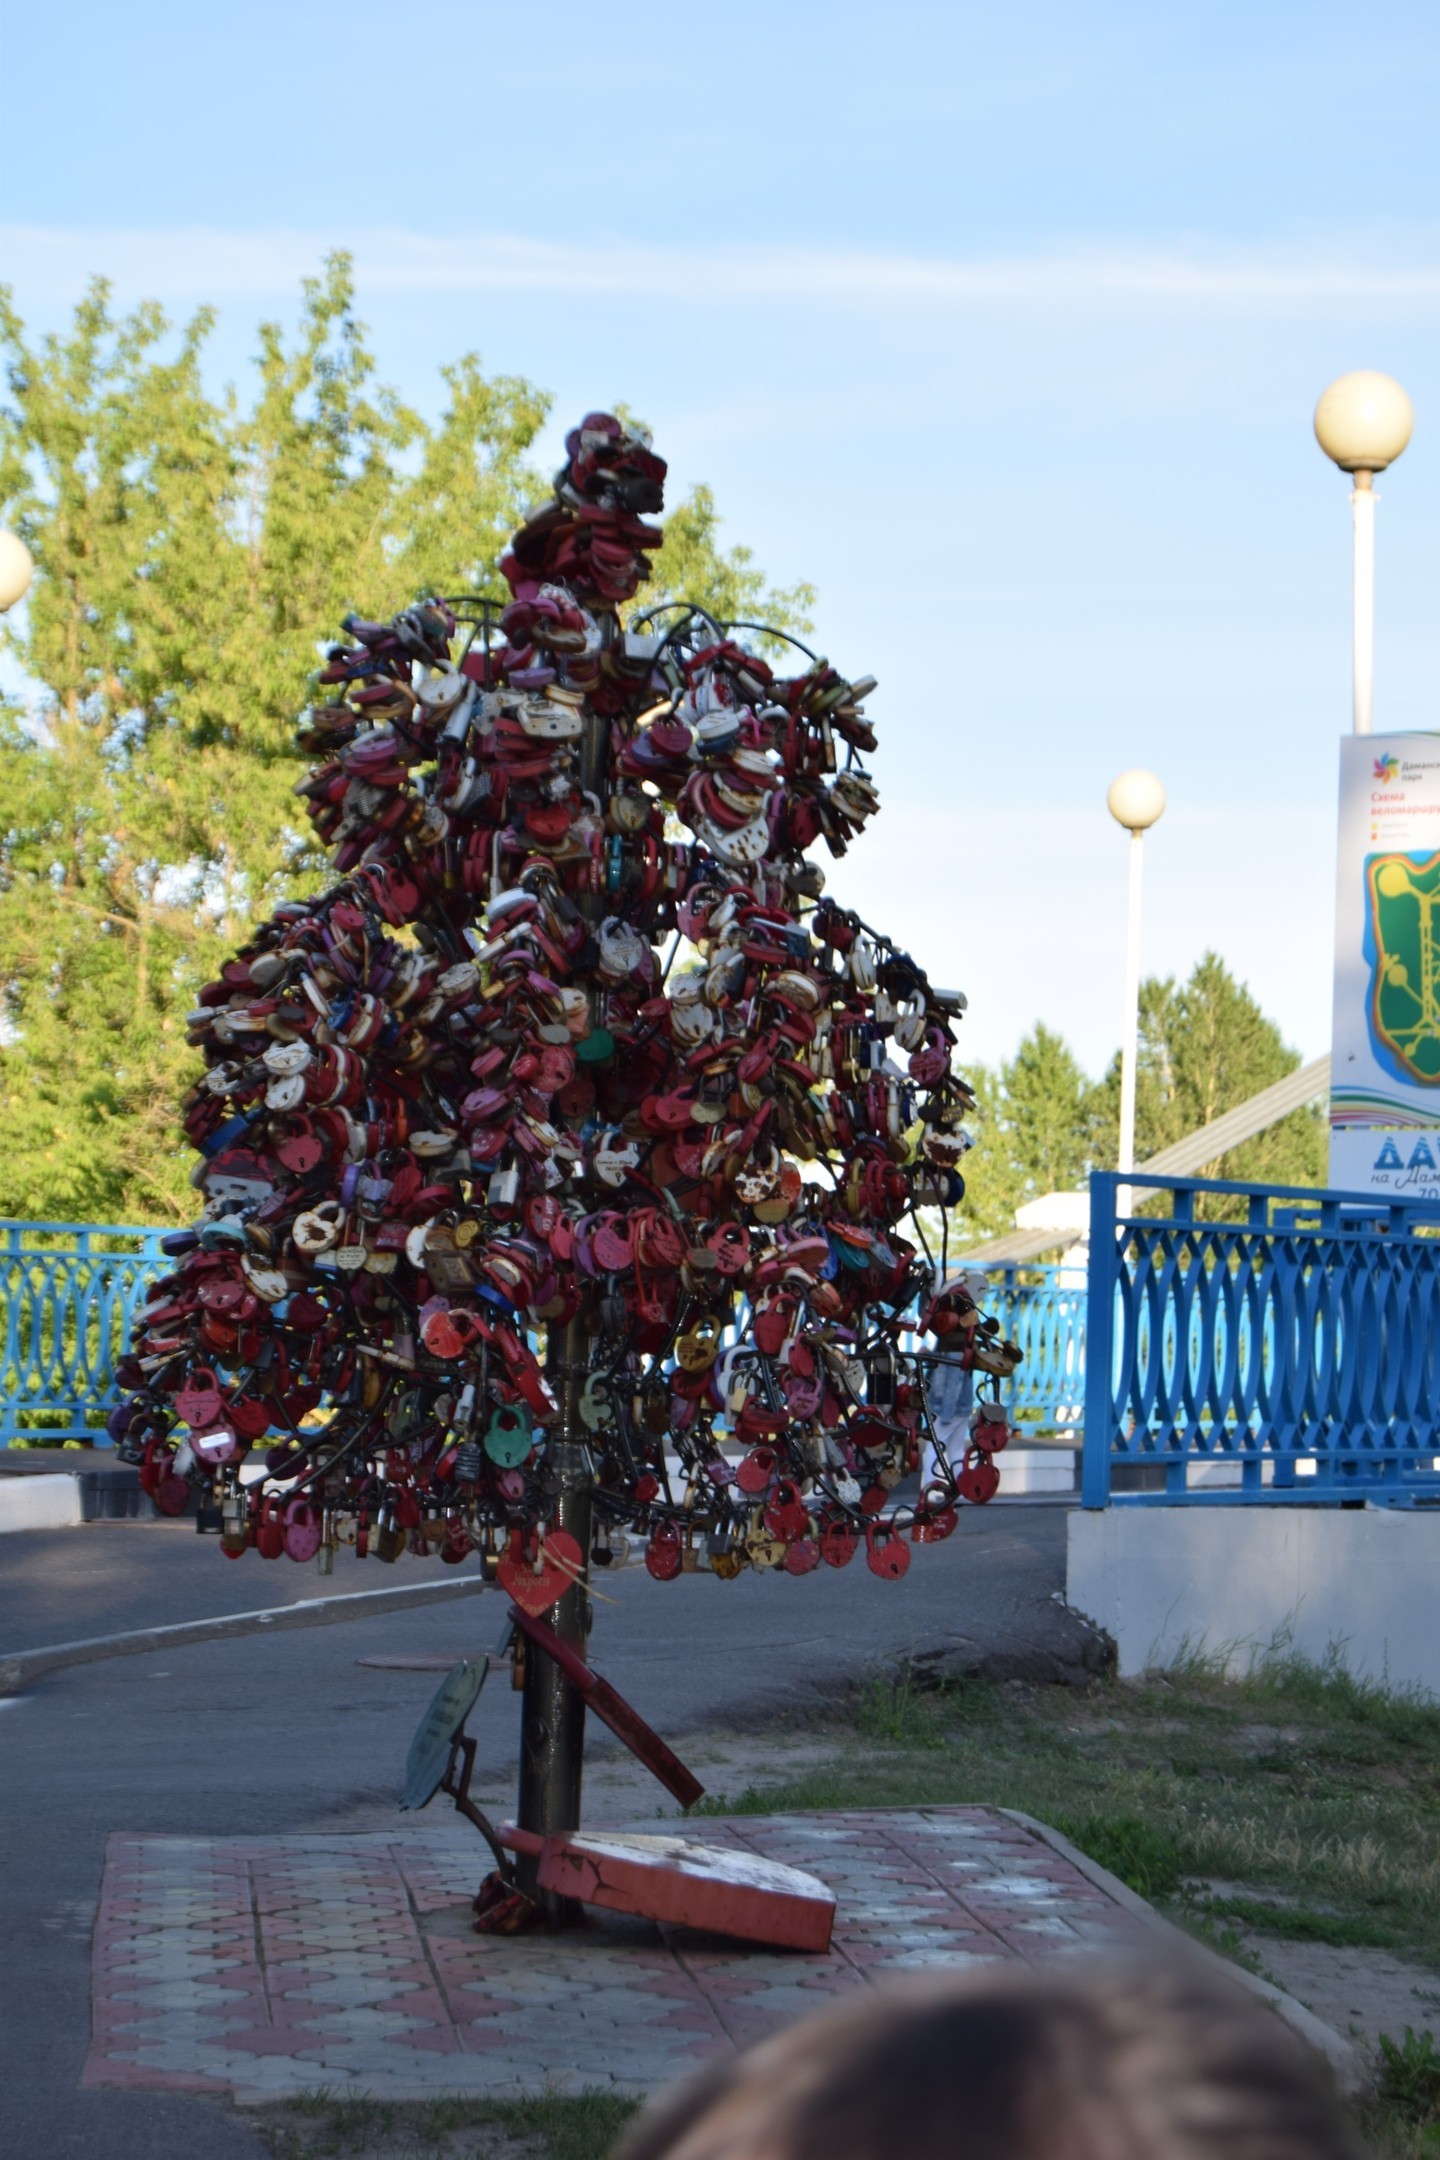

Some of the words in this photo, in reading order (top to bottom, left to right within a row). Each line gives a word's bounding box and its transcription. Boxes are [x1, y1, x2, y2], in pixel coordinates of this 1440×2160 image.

[1402, 773, 1423, 782] парк
[1371, 792, 1405, 802] Схема
[1374, 1136, 1440, 1169] ДА
[1370, 1172, 1390, 1183] на
